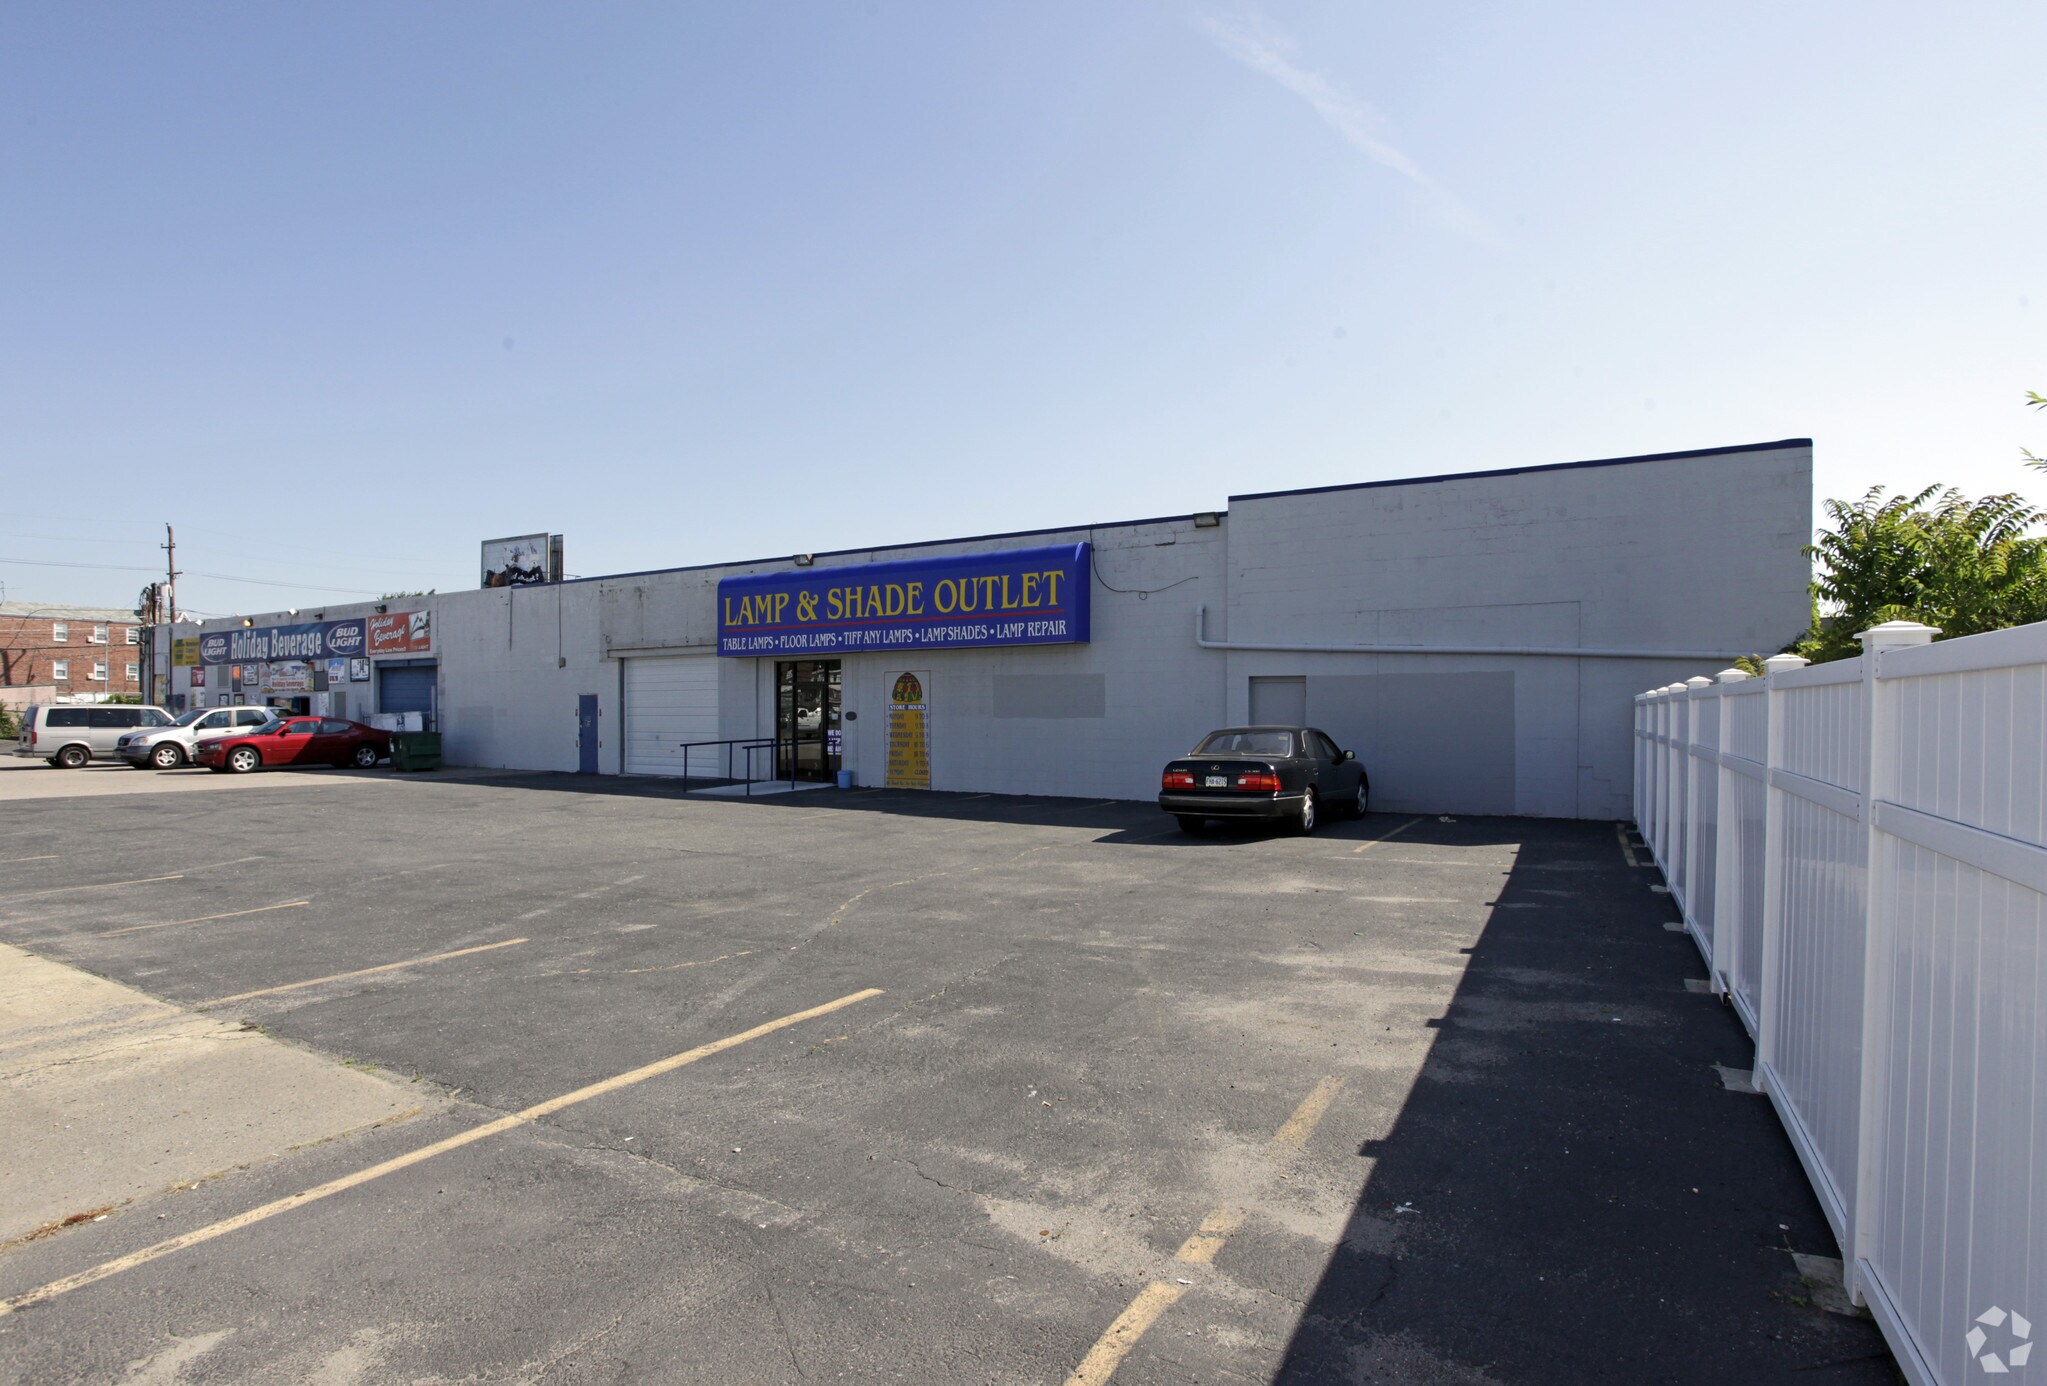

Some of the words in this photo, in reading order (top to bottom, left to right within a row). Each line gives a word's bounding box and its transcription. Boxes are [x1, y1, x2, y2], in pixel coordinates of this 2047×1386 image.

[724, 592, 789, 626] LAMP
[796, 590, 819, 622] &
[826, 582, 925, 620] SHADE
[934, 570, 1065, 613] OUTLET
[370, 616, 394, 631] Holiday
[336, 626, 359, 637] BUD
[374, 624, 405, 646] Beverage
[722, 637, 747, 650] TABLE
[748, 636, 774, 649] LAMPS
[780, 634, 808, 648] FLOOR
[809, 632, 837, 647] LAMPS
[882, 628, 913, 644] LAMPS
[996, 622, 1025, 638] LAMP
[1027, 619, 1067, 637] REPAIR
[207, 638, 225, 647] BUD
[231, 630, 269, 660] Holiday
[271, 628, 322, 658] Beverage
[330, 636, 362, 648] LIGHT
[204, 646, 228, 656] LIGHT
